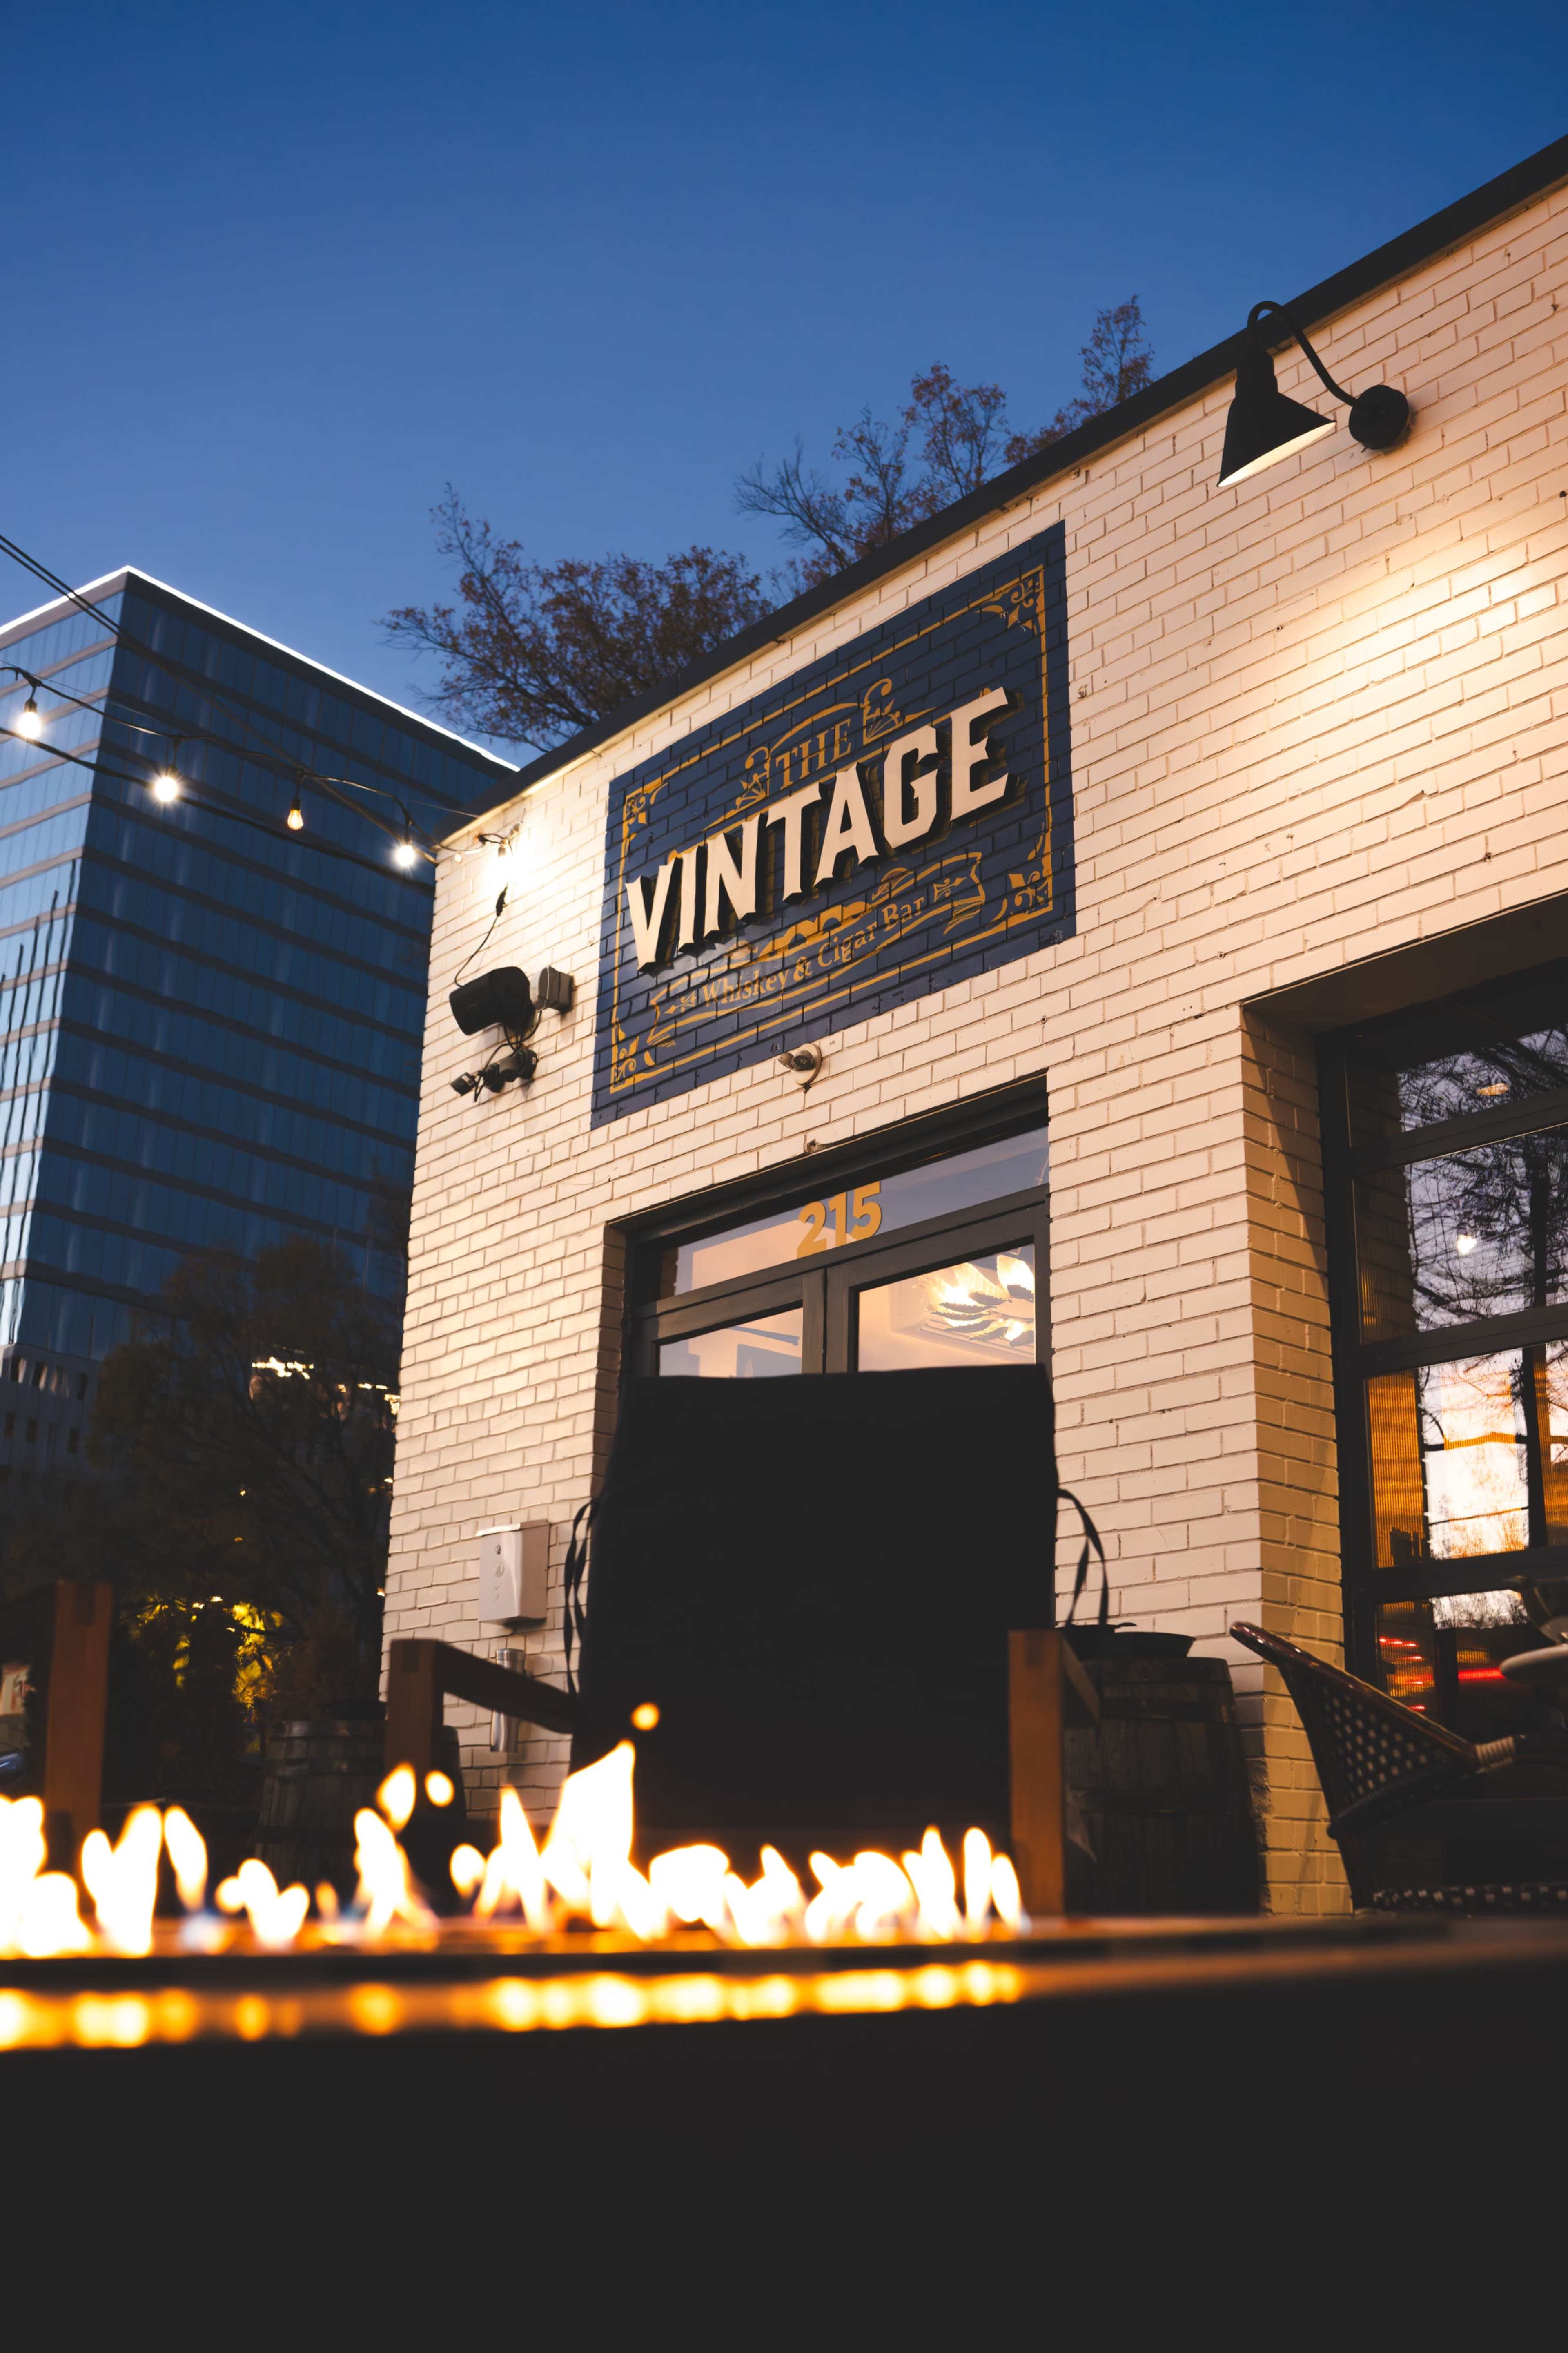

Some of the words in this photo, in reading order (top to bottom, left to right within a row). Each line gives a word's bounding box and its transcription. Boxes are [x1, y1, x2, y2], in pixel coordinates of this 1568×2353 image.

[775, 718, 851, 790] THE
[625, 686, 1011, 972] VINTAGE
[702, 968, 791, 1007] Whiskey
[793, 956, 813, 981] &
[817, 921, 878, 967] Cigar
[882, 897, 924, 932] Bar
[796, 1180, 882, 1258] 215
